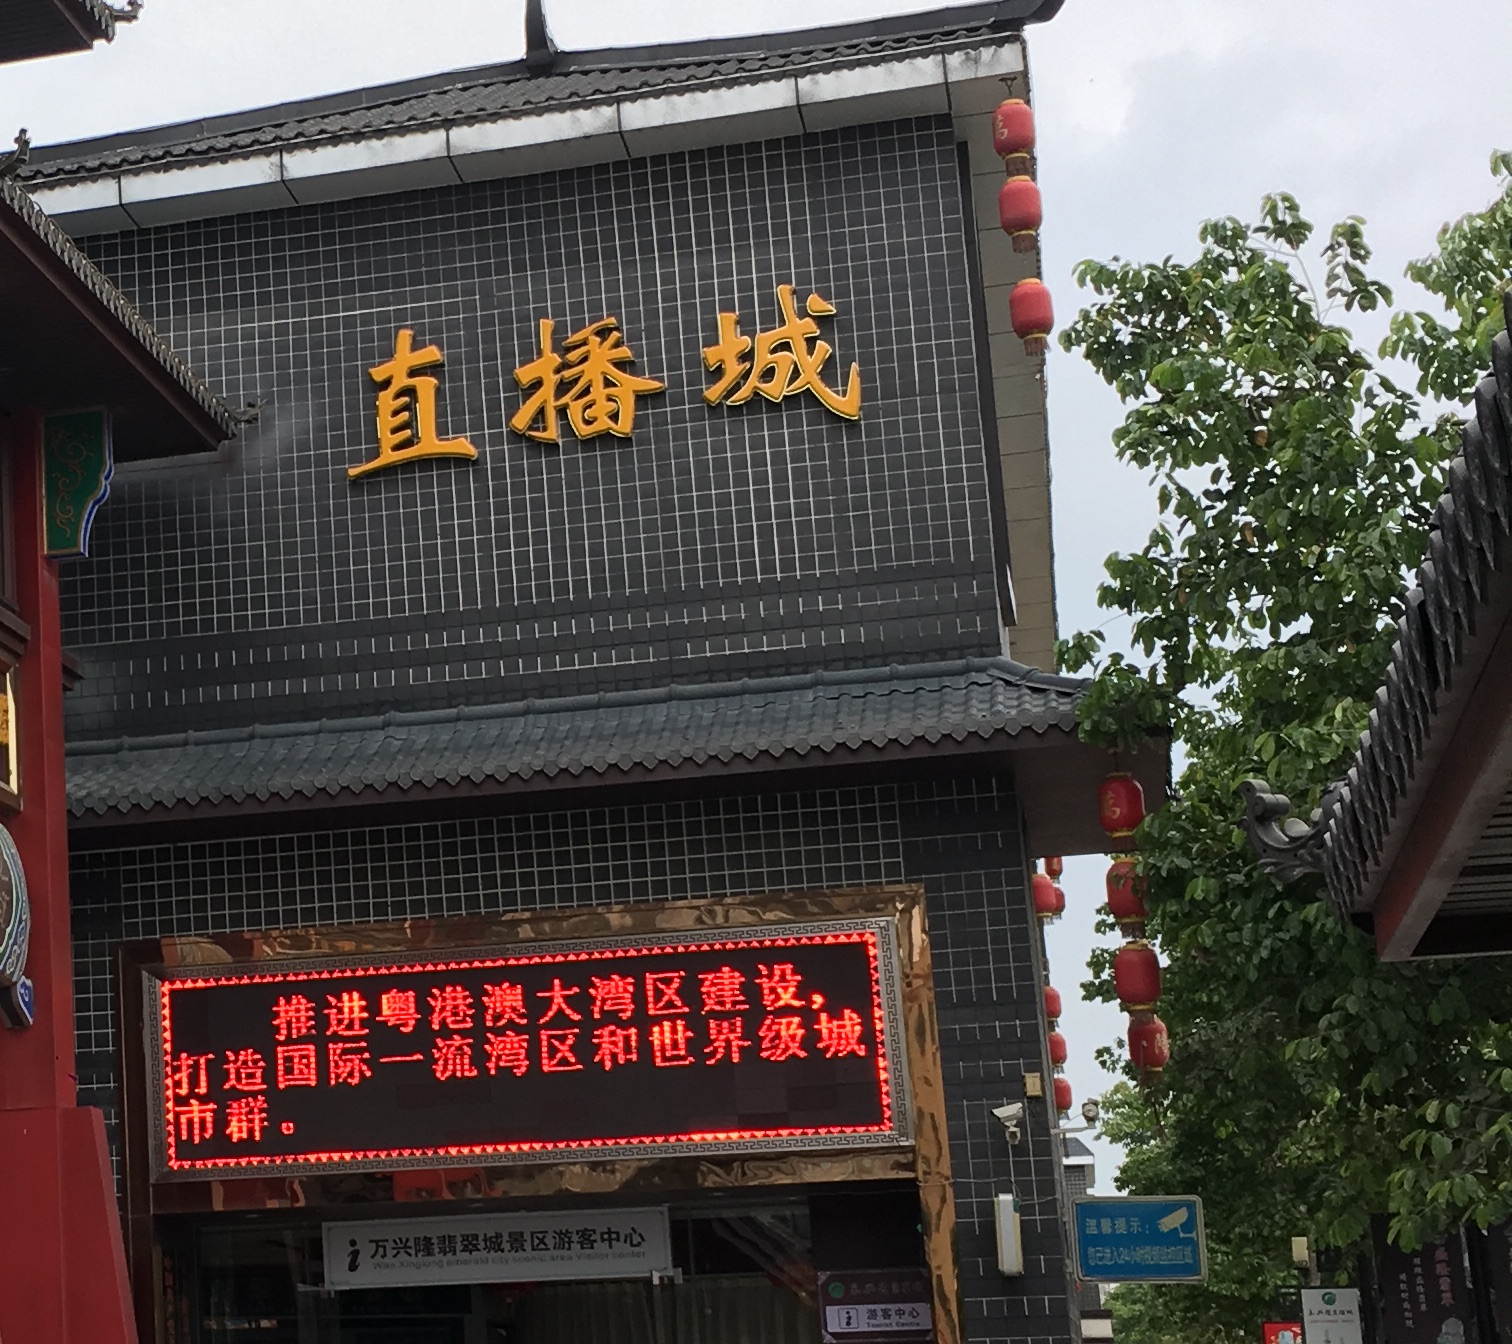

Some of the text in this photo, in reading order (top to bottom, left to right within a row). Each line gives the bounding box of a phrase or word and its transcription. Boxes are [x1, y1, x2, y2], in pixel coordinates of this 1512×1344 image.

[347, 284, 862, 480] 直播城
[172, 1009, 868, 1098] 打造国际一流湾区和世界级城
[368, 1226, 647, 1261] 万兴隆翡翠城景区游客中心
[866, 1307, 920, 1321] 游客中心
